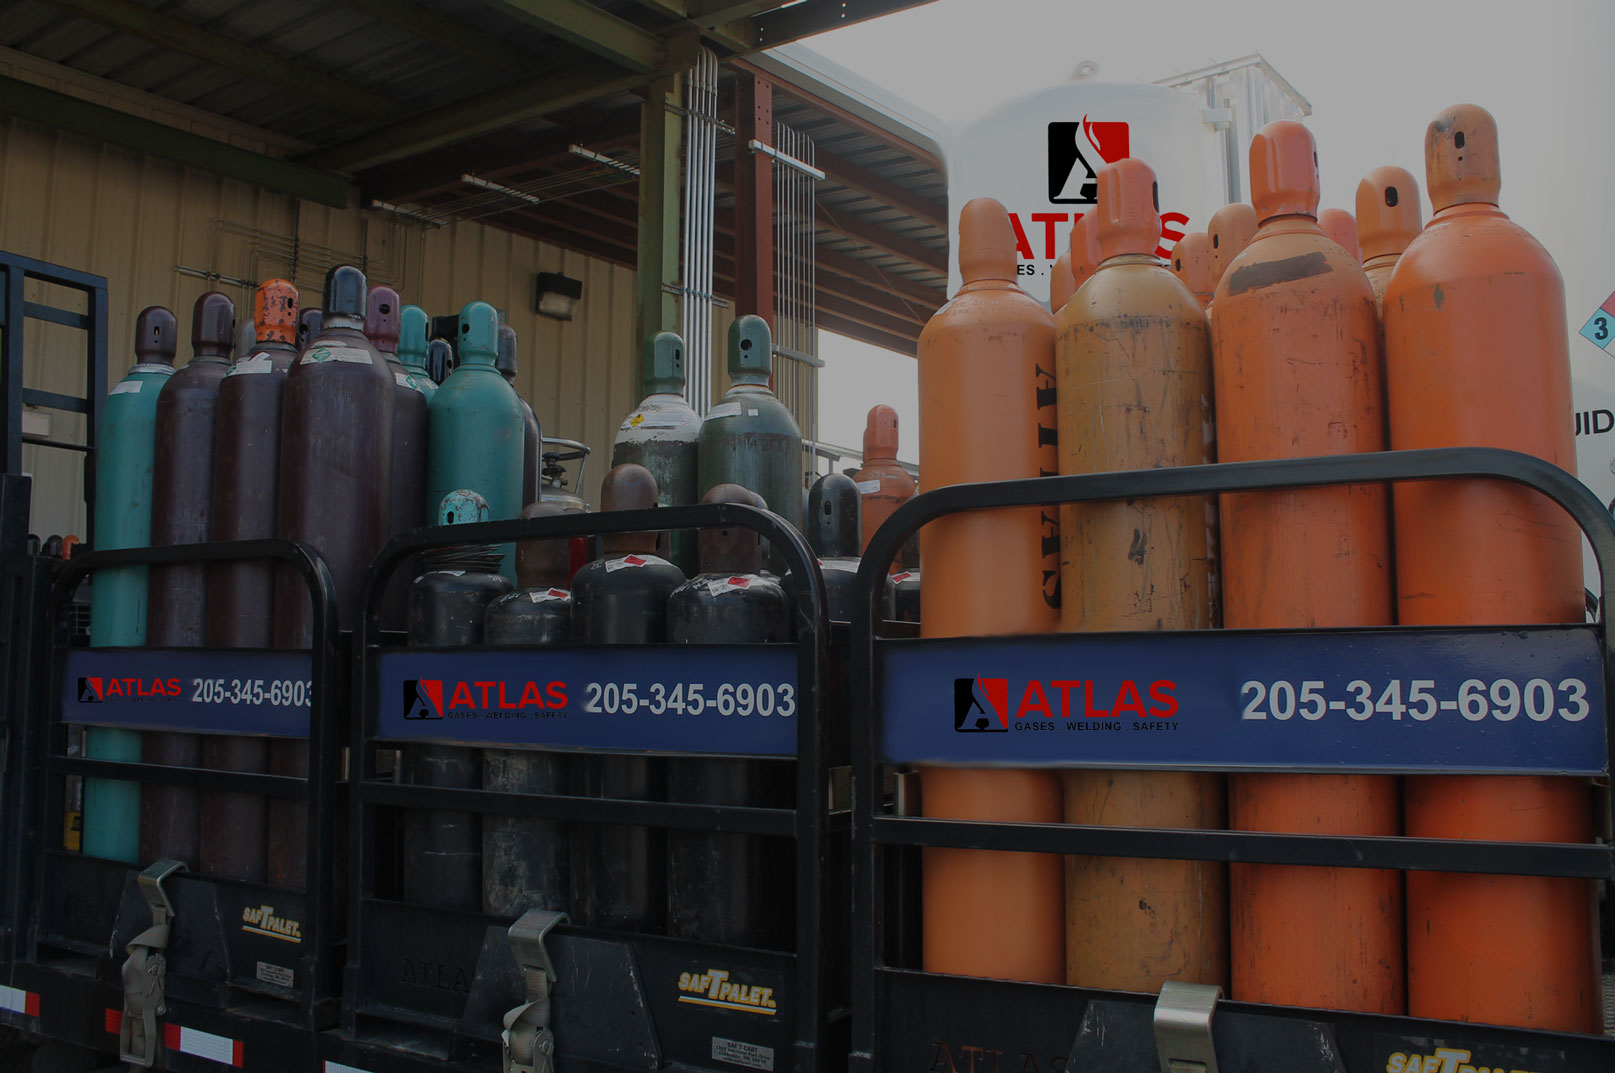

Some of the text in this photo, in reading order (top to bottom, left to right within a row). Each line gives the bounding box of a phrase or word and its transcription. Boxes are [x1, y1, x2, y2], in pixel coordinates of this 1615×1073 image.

[1008, 212, 1191, 260] ATS
[1594, 317, 1609, 340] 3
[106, 677, 182, 697] ATLAS
[448, 681, 569, 709] ATLAS
[585, 682, 796, 718] 205-345-6903
[1016, 680, 1179, 718] ATLAS
[1241, 678, 1590, 722] 205-345-6903
[1014, 721, 1179, 732] GASES WELDING SAFETY
[400, 957, 470, 993] ATLA
